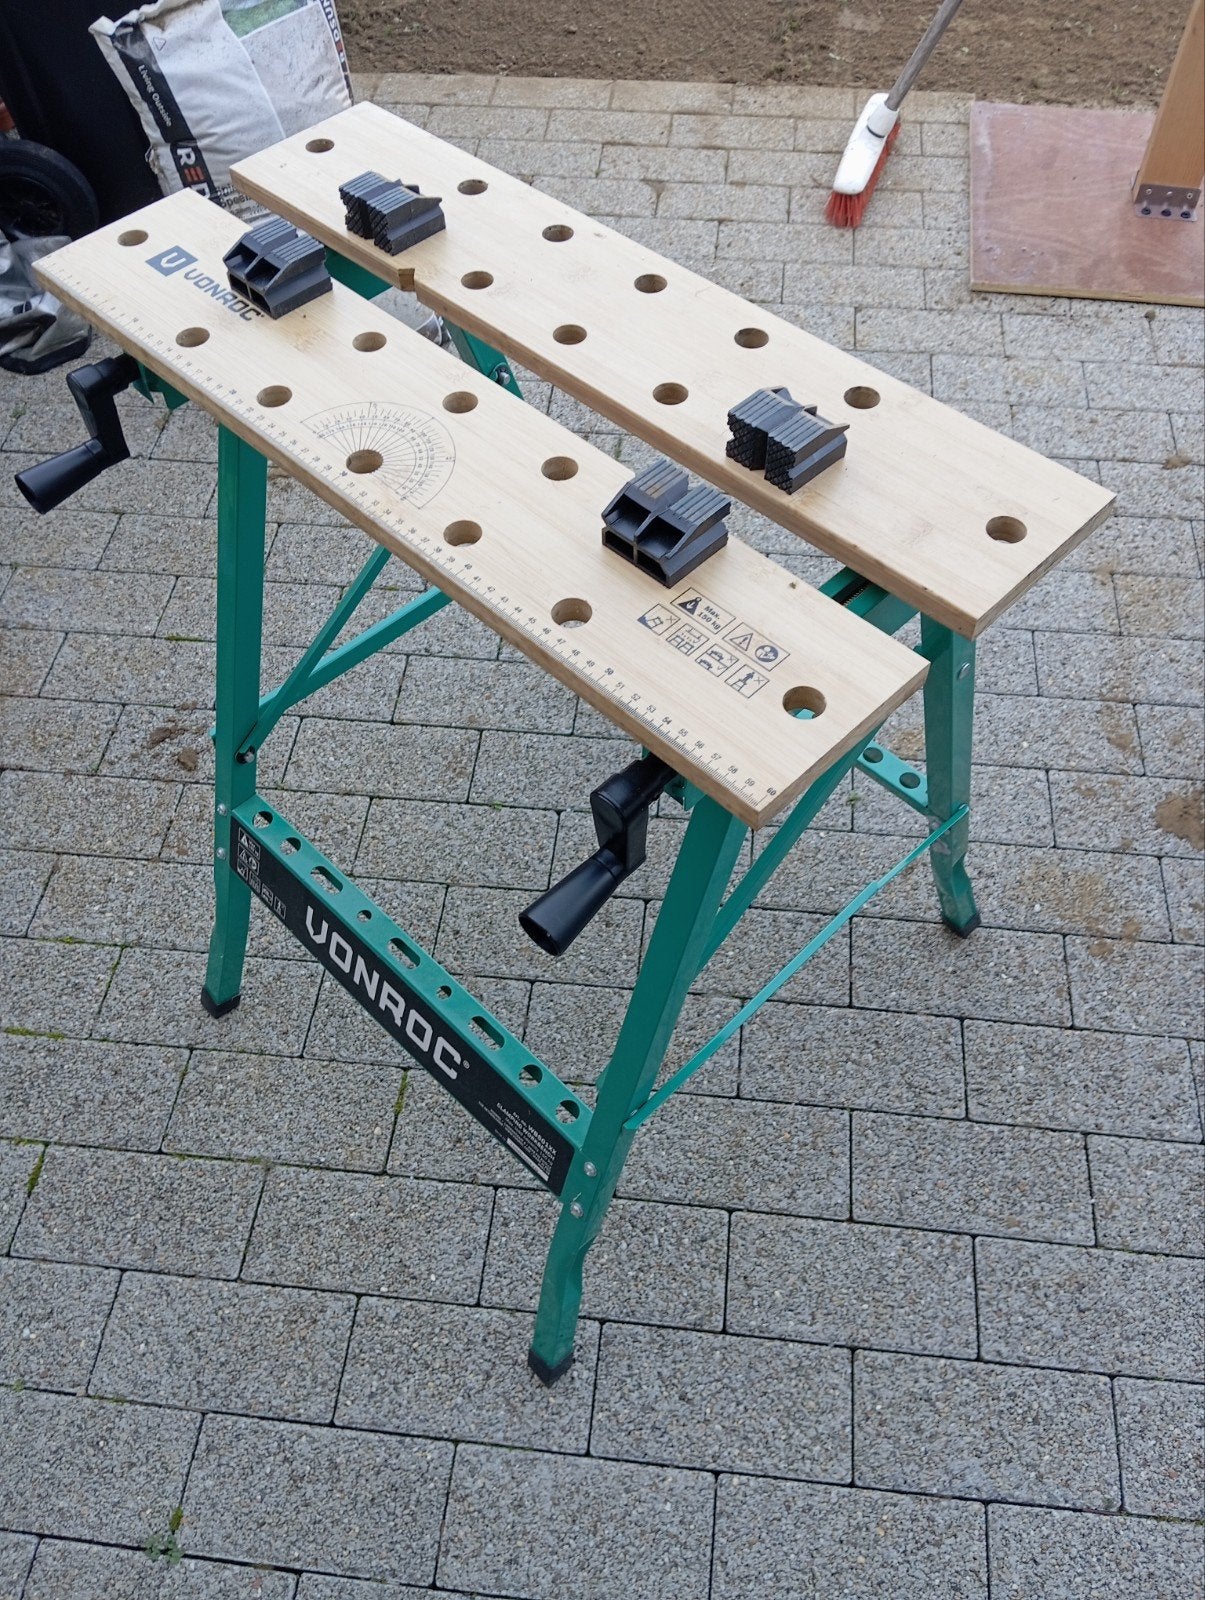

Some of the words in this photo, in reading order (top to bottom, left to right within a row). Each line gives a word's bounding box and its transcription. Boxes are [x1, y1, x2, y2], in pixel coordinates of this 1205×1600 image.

[138, 64, 155, 94] Living
[152, 92, 172, 127] Outside
[184, 268, 262, 321] VONROC
[697, 612, 711, 624] 150
[710, 620, 721, 630] kg
[704, 605, 720, 620] Max.
[542, 627, 552, 635] 46
[572, 649, 581, 657] 48
[586, 660, 596, 668] 49
[604, 667, 614, 676] 50
[615, 681, 625, 690] 51
[630, 693, 641, 702] 52
[646, 705, 656, 714] 53
[662, 716, 673, 726] 54
[678, 728, 688, 737] 55
[694, 740, 705, 750] 56
[710, 753, 722, 761] 57
[727, 765, 738, 774] 58
[744, 778, 755, 787] 59
[766, 787, 777, 796] 60
